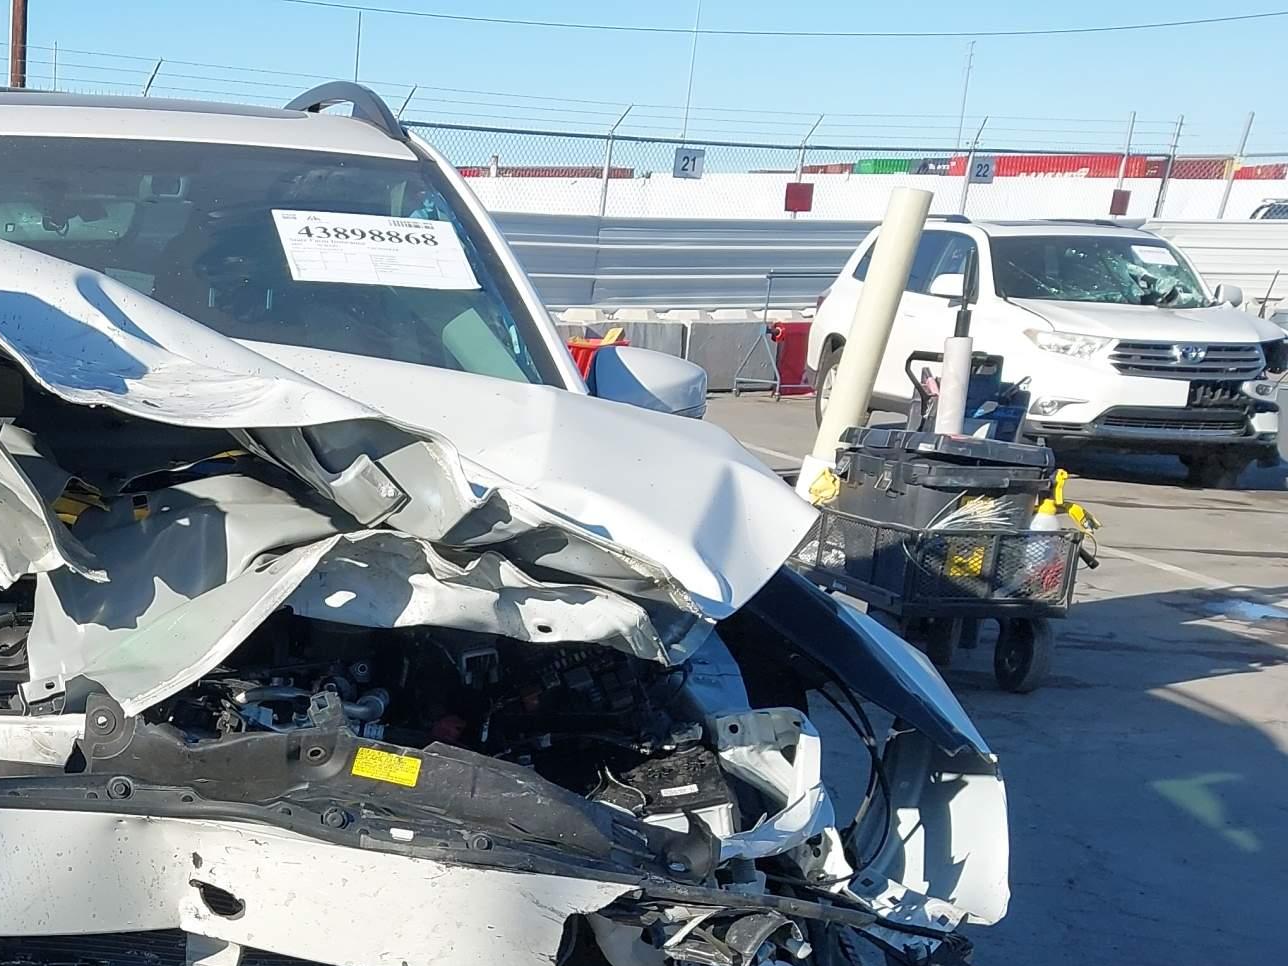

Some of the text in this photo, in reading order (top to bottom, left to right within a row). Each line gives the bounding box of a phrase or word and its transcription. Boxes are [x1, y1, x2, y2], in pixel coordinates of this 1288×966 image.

[681, 156, 697, 172] 21
[975, 163, 990, 178] 22
[297, 225, 439, 247] 43898868
